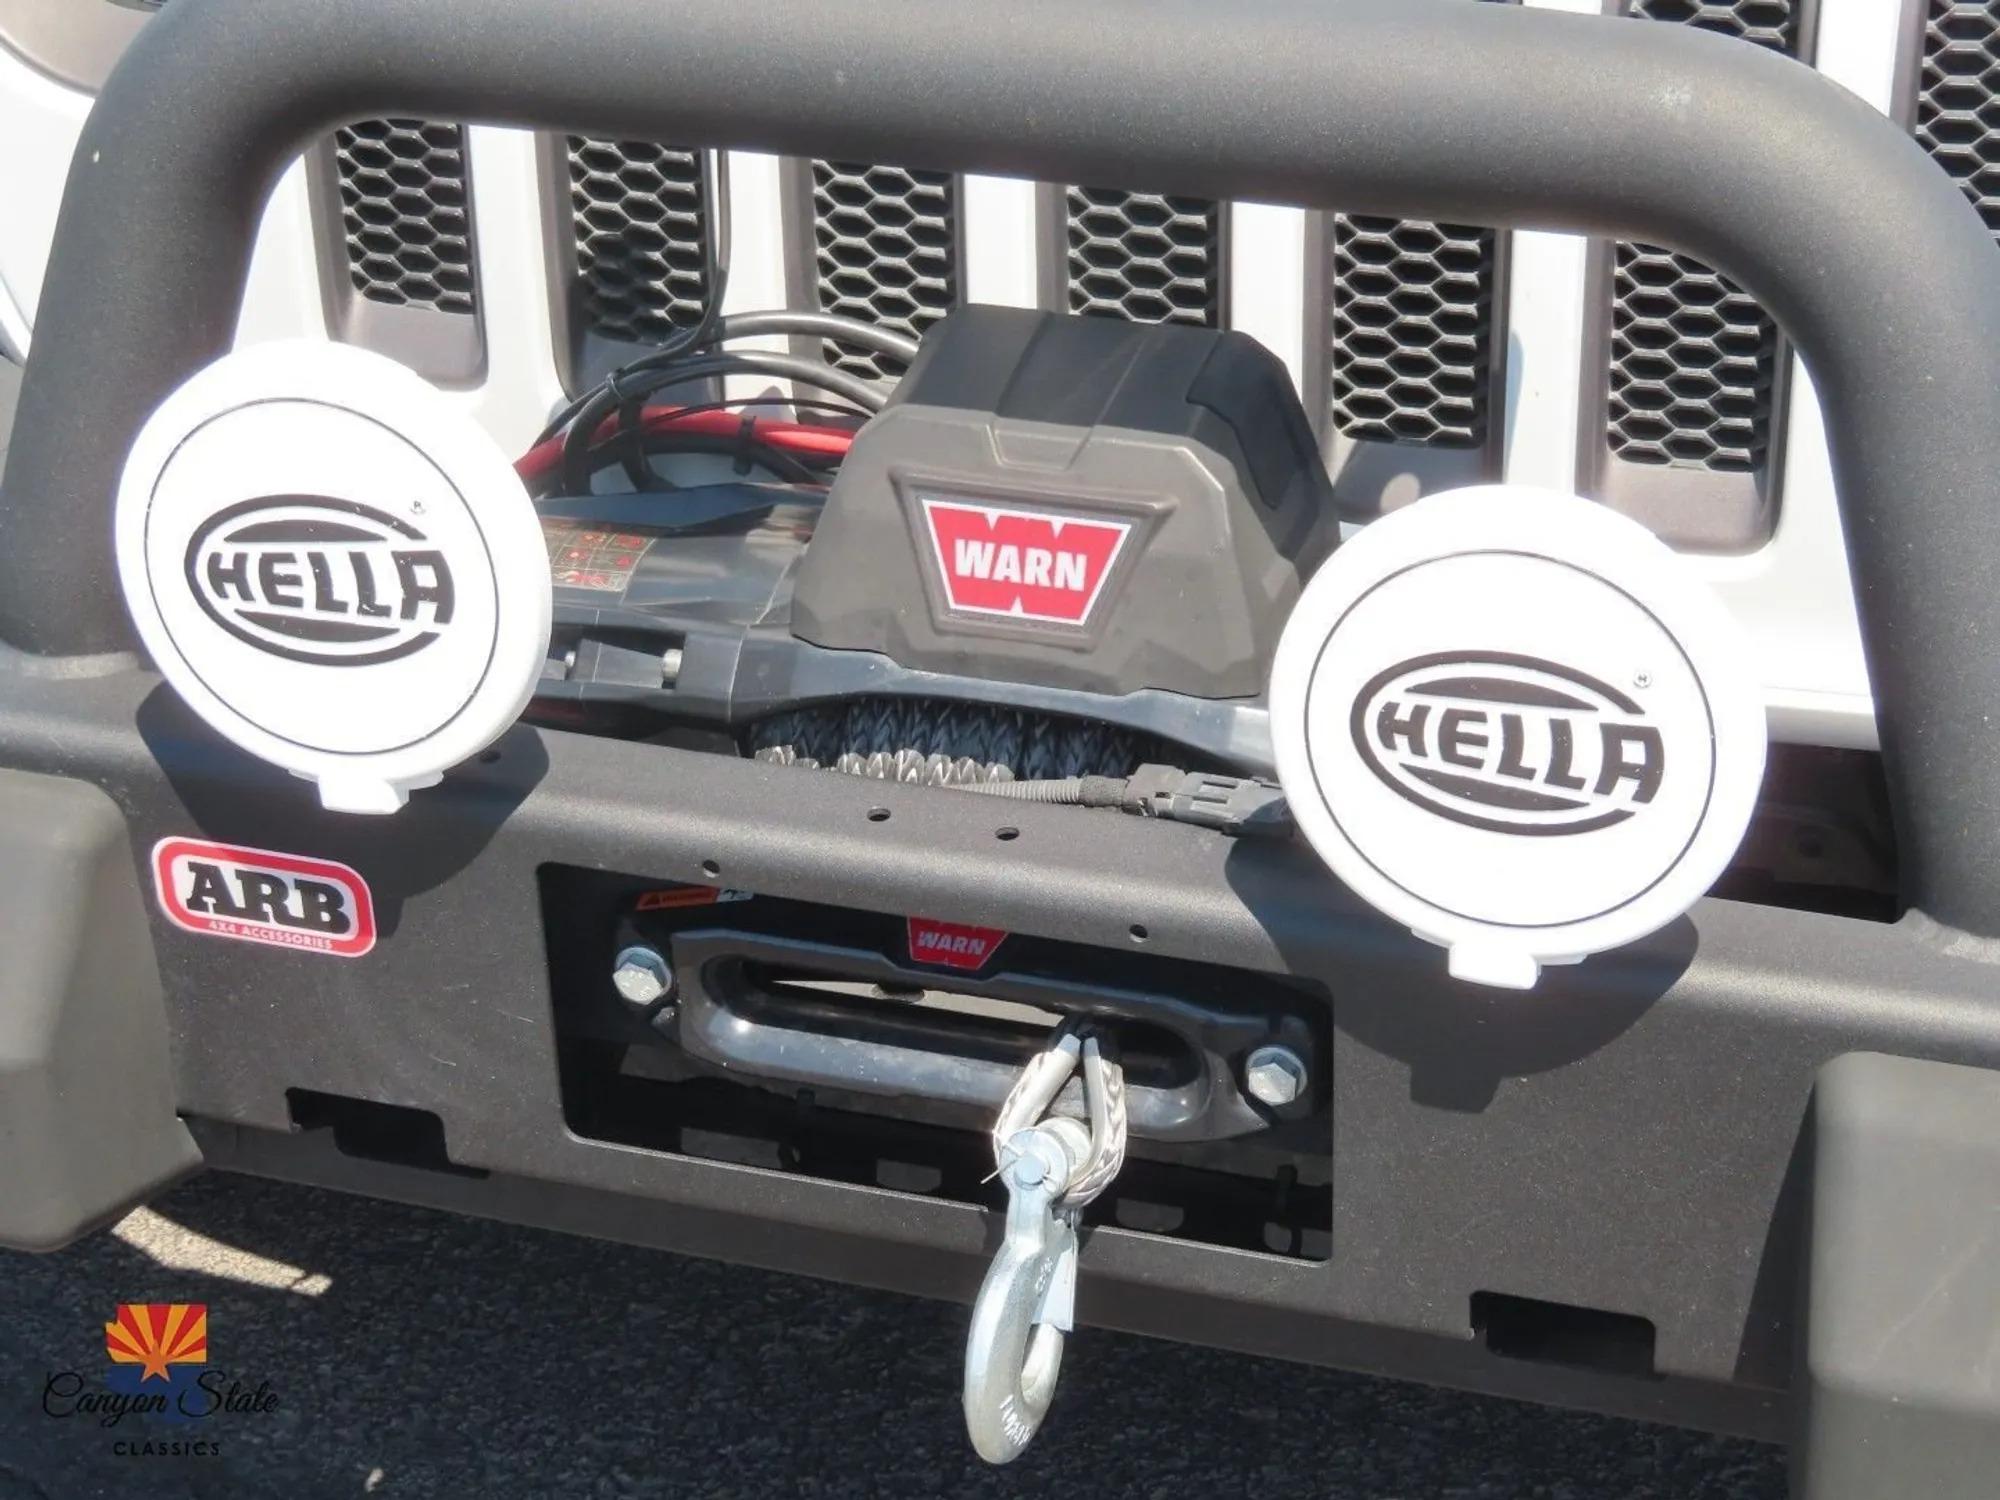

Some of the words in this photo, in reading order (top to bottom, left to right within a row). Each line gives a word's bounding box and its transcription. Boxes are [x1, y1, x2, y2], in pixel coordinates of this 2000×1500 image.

[207, 550, 455, 625] HELLA
[955, 538, 1087, 592] WARN
[1377, 701, 1664, 803] HELLA
[186, 861, 351, 934] ARB
[240, 926, 333, 950] ACCESSORIES
[917, 931, 986, 955] WARN
